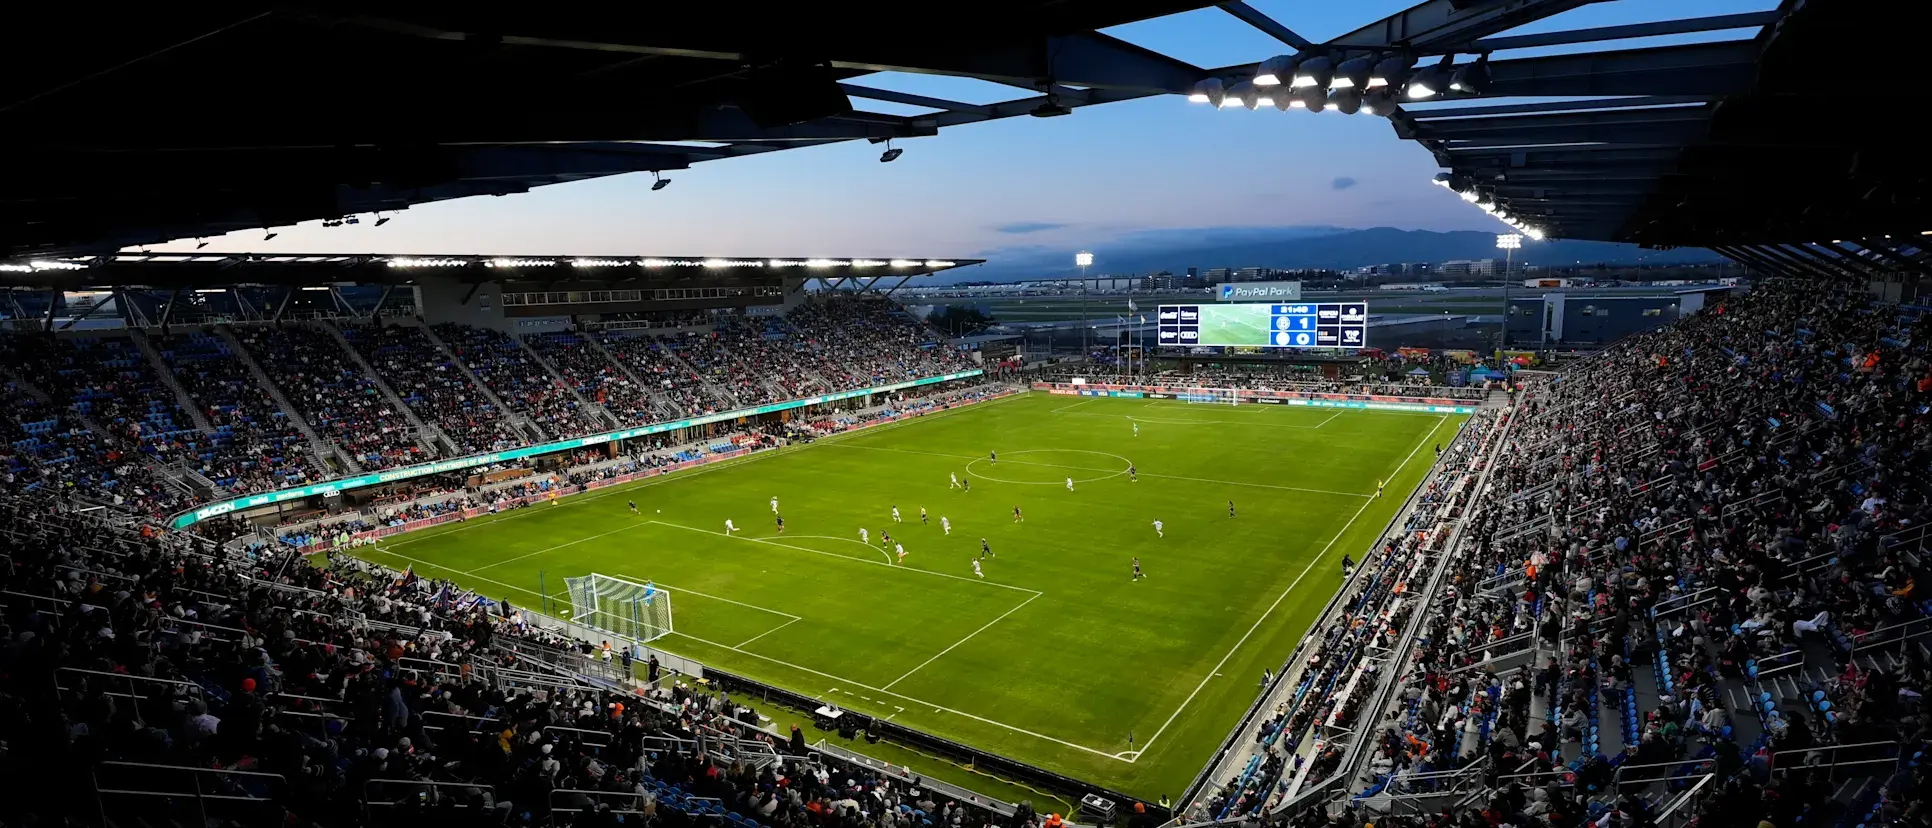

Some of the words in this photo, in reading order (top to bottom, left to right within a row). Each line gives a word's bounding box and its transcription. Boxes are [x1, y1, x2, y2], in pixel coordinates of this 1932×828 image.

[1235, 287, 1268, 298] PayPal
[1269, 286, 1293, 296] Park
[1299, 317, 1308, 329] 1
[1296, 333, 1310, 345] 0
[379, 467, 433, 482] CONSTRUCTION
[434, 461, 468, 472] PARTNERS
[468, 458, 477, 466] OF
[491, 454, 499, 462] FC
[276, 490, 305, 502] perform
